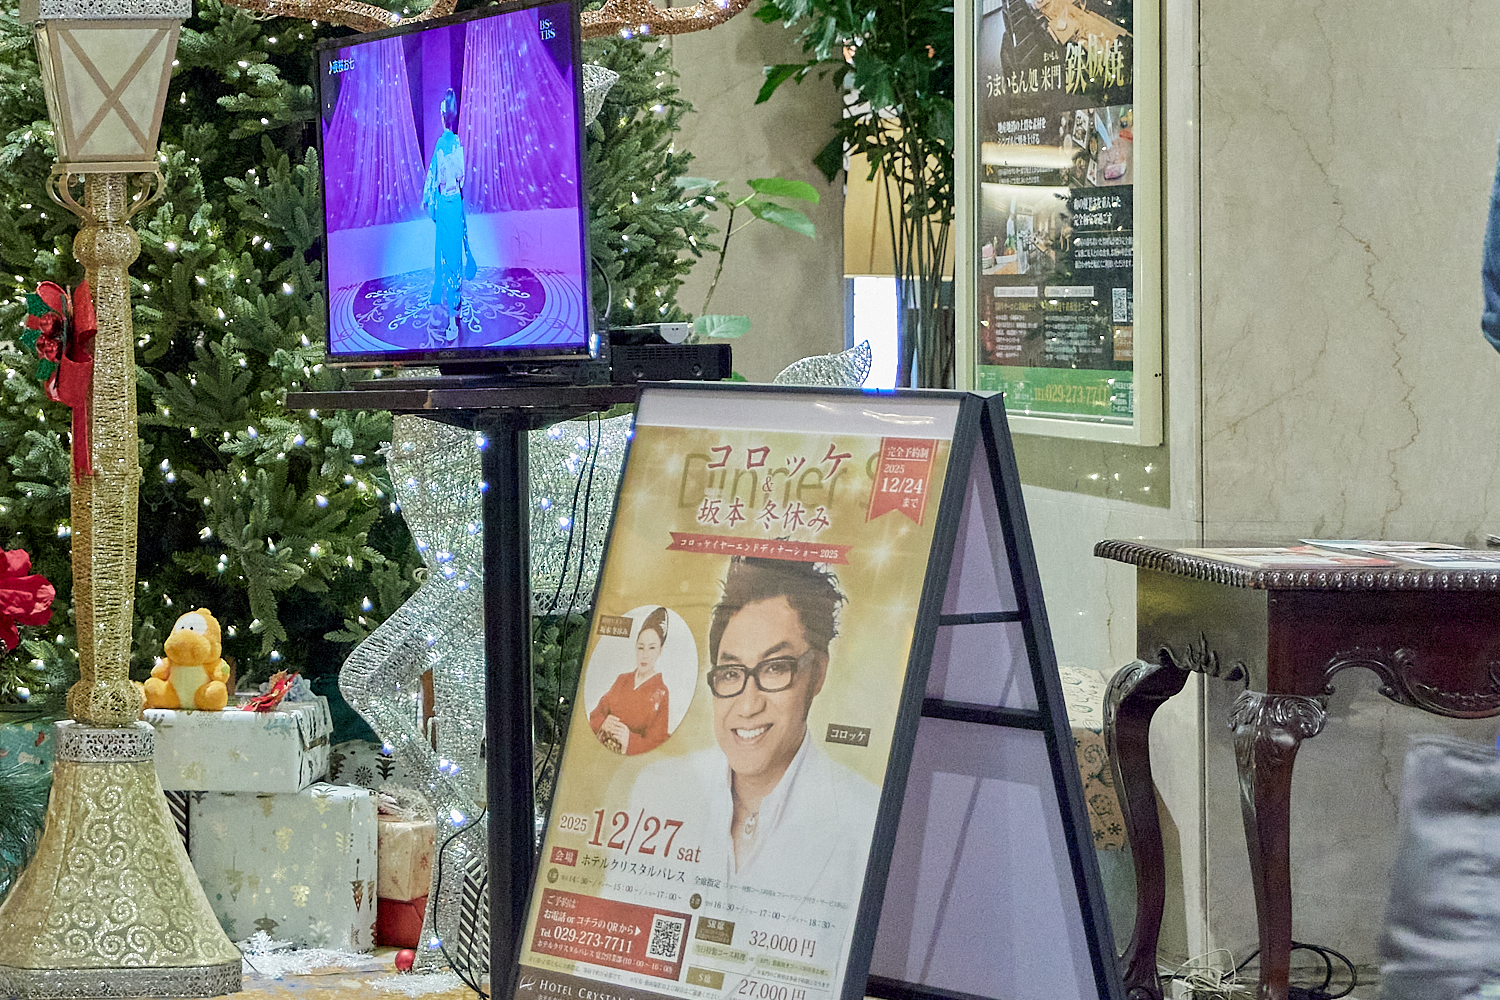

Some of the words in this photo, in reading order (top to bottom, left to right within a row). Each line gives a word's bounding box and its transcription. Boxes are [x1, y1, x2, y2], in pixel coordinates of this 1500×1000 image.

[540, 28, 556, 40] TBS
[985, 68, 1039, 98] うまいもん処
[1040, 64, 1062, 91] 米門
[1065, 32, 1126, 95] 鉄板焼
[887, 446, 930, 458] 完全予約制
[707, 443, 852, 480] コロッケ
[884, 463, 905, 474] 2025
[761, 476, 774, 493] &
[881, 477, 923, 494] 12/24
[902, 497, 919, 508] まで
[697, 497, 745, 528] 坂本
[756, 501, 830, 532] 冬休み
[819, 550, 839, 559] 2025
[830, 729, 866, 742] コロッケ
[560, 815, 587, 832] 2025
[588, 808, 684, 858] 12/27
[676, 845, 702, 863] sat
[554, 851, 574, 863] 会場
[581, 854, 686, 883] ホテルクリスタルパレス
[546, 895, 576, 909] ご予約は
[553, 925, 633, 954] 029-273-7711
[539, 979, 572, 996] HOTEL
[578, 987, 621, 1000] CRYST
